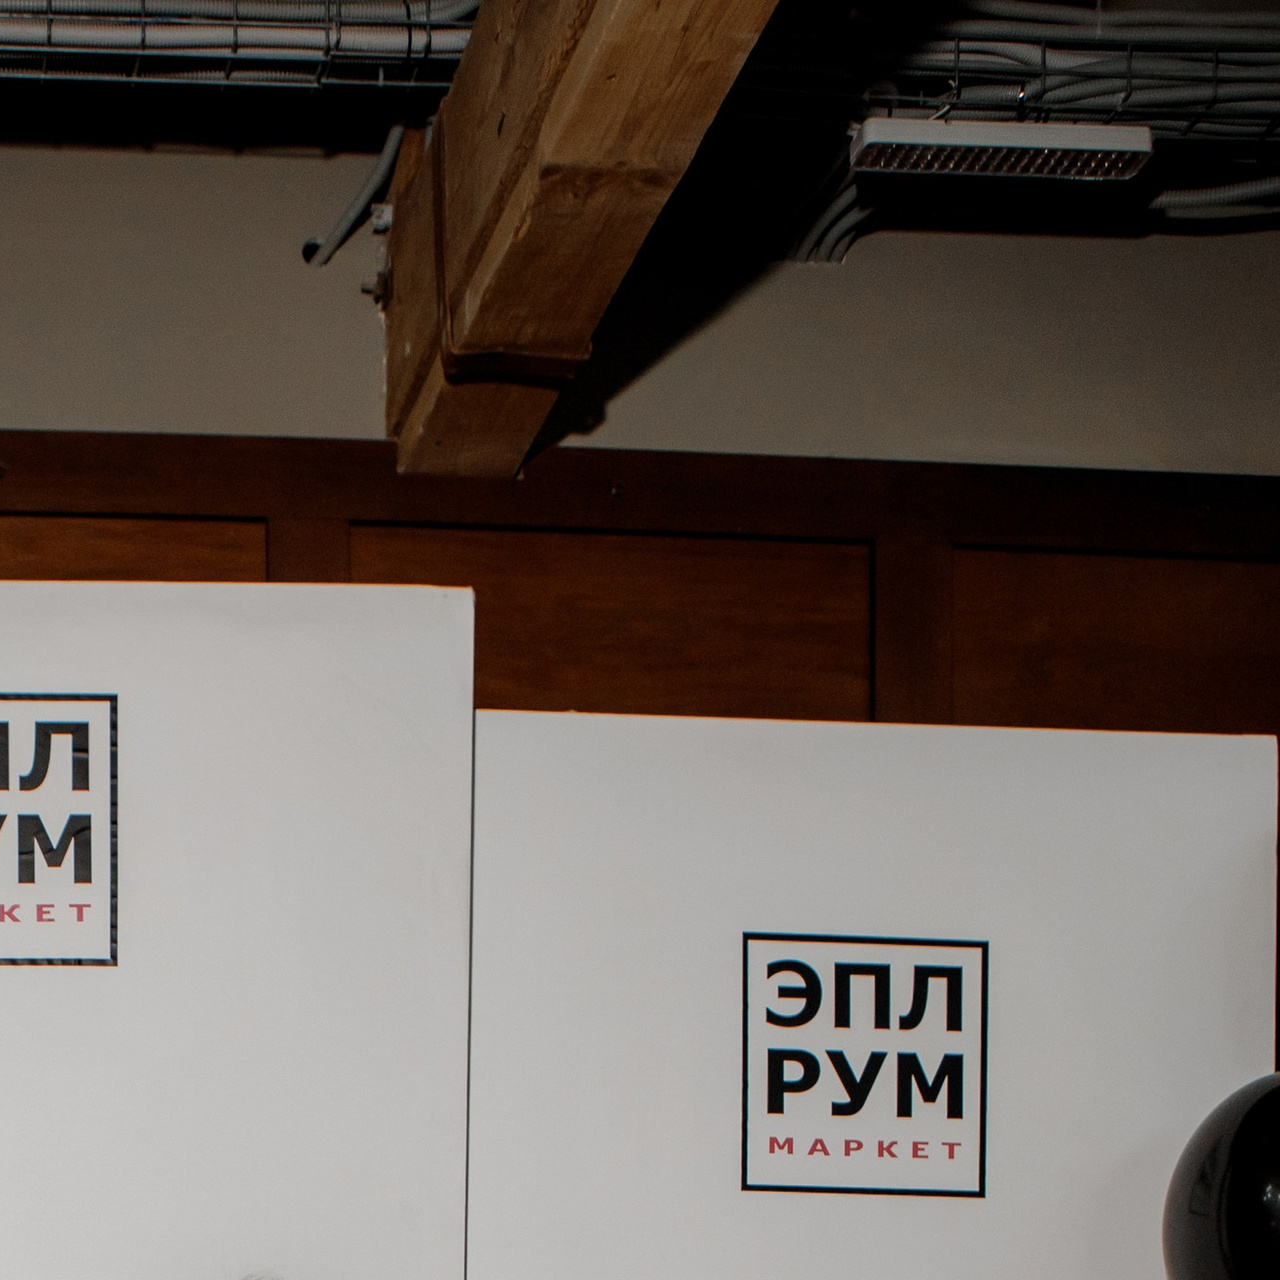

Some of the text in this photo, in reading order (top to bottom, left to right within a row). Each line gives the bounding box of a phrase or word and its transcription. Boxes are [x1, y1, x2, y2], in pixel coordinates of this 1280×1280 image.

[766, 959, 963, 1032] ЭПЛ
[767, 1048, 964, 1120] РУМ
[768, 1136, 962, 1160] МАРКЕТ
